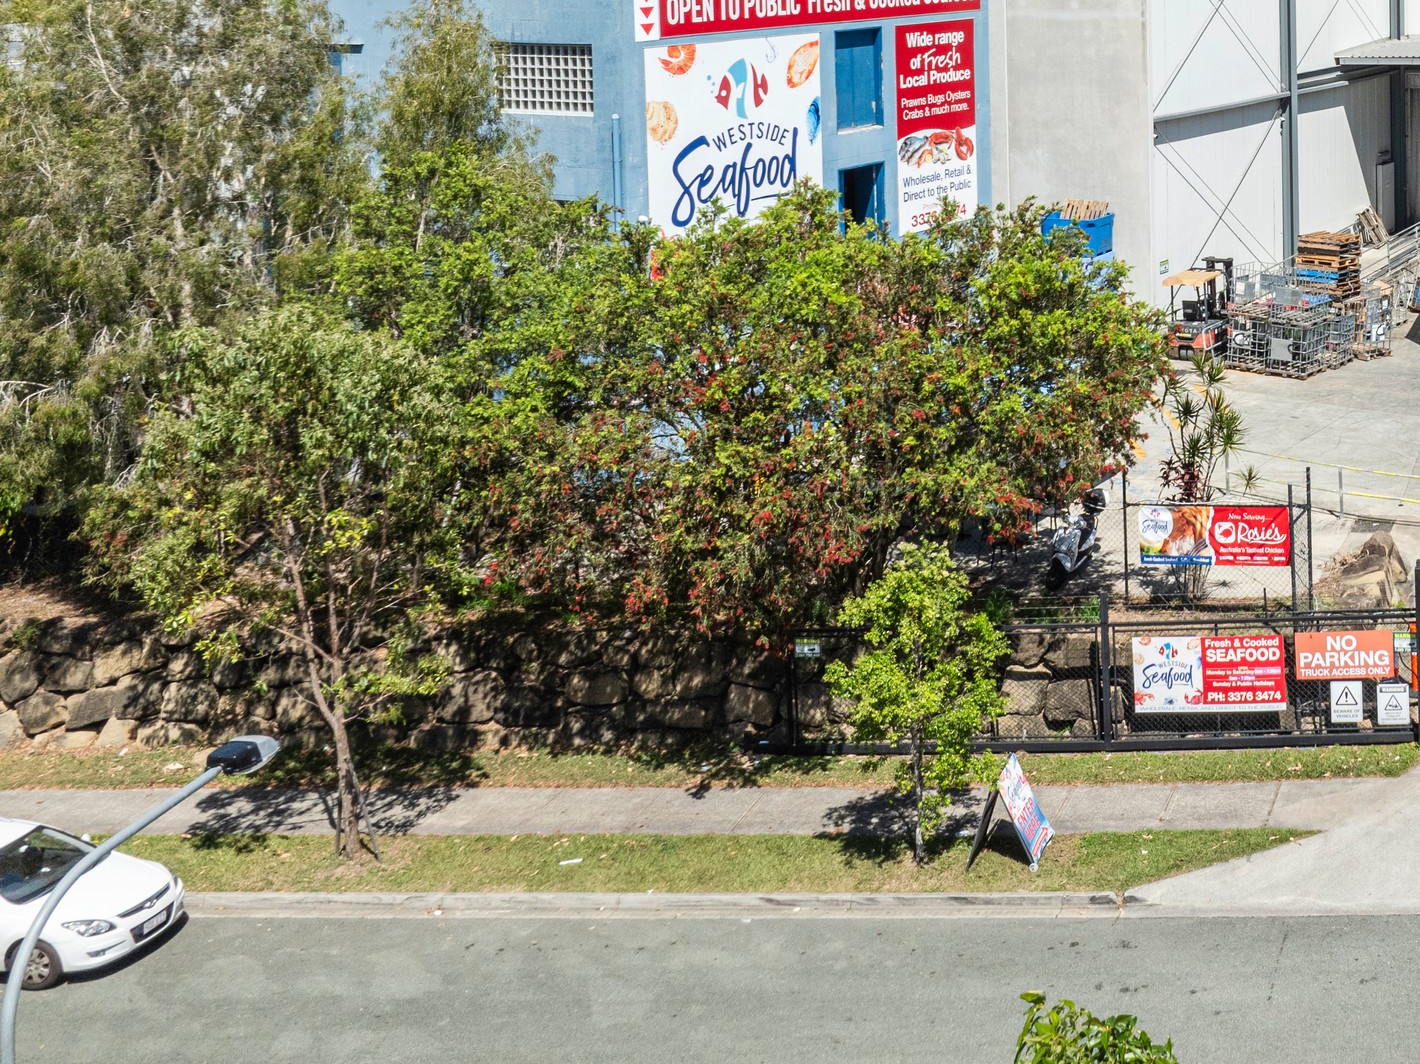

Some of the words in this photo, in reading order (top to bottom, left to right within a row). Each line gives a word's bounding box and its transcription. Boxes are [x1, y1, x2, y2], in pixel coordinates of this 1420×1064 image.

[906, 31, 933, 48] Wide
[935, 31, 964, 47] range
[910, 53, 921, 70] of
[923, 47, 961, 70] Fresh
[900, 71, 928, 89] Local
[930, 68, 971, 85] Produce
[901, 97, 926, 108] Prawns
[928, 94, 945, 105] Bugs
[946, 90, 971, 103] Oysters
[903, 109, 924, 120] Crabs
[925, 106, 930, 117] &
[931, 104, 950, 115] much
[951, 102, 969, 112] more.
[712, 122, 789, 152] WESTSIDE
[671, 127, 798, 227] Seafood
[903, 172, 943, 188] Wholesale,
[944, 166, 965, 179] Retail
[966, 164, 972, 175] &
[903, 189, 926, 203] Direct
[927, 188, 935, 197] to
[937, 185, 948, 195] the
[950, 179, 972, 192] Public
[1237, 522, 1287, 544] Rosie's
[1205, 639, 1231, 648] Fresh
[1233, 638, 1241, 647] &
[1243, 637, 1279, 647] Cooked
[1326, 635, 1357, 651] NO
[1206, 647, 1280, 662] SEAFOOD
[1299, 650, 1390, 667] PARKING
[1158, 660, 1188, 669] WESTSIDE
[1300, 668, 1330, 676] TRUCK
[1332, 667, 1366, 676] ACCESS
[1367, 666, 1391, 675] ONLY
[1142, 663, 1194, 690] Seafood
[1207, 692, 1226, 702] PH:
[1227, 691, 1254, 701] 3376
[1255, 690, 1282, 701] 3474
[1017, 797, 1035, 832] ENTER
[1024, 812, 1041, 844] HERE
